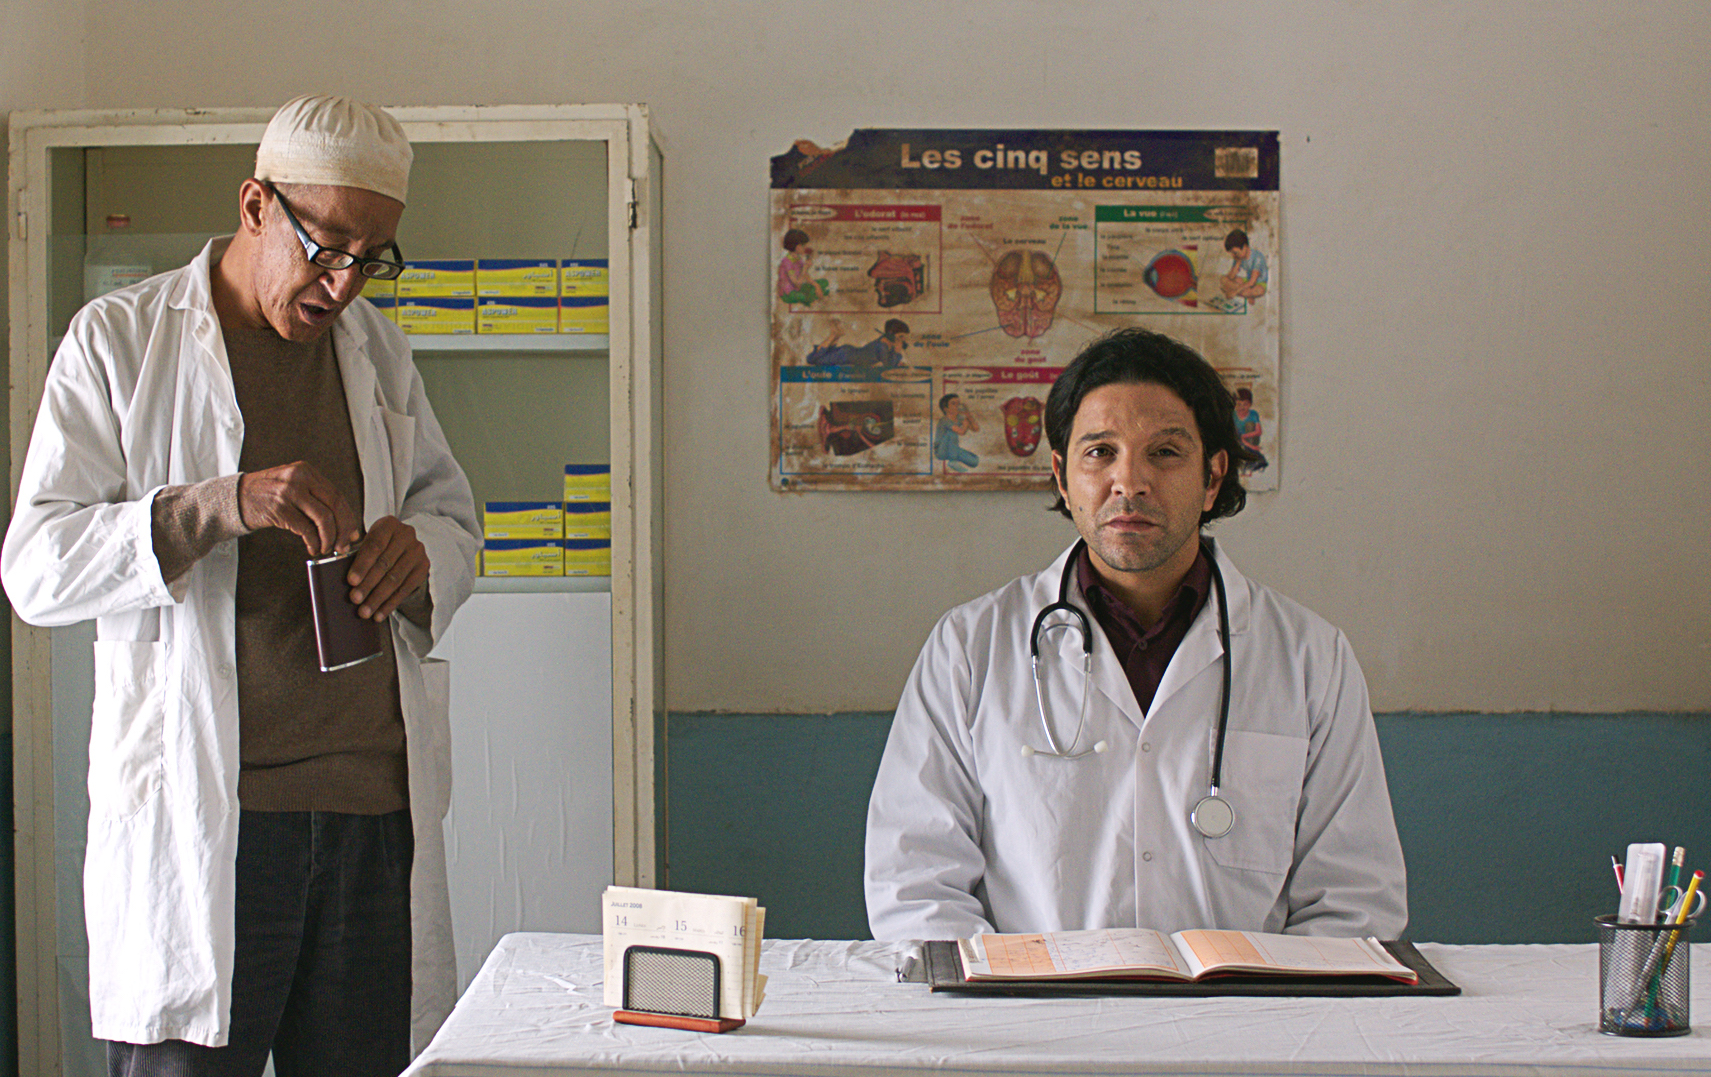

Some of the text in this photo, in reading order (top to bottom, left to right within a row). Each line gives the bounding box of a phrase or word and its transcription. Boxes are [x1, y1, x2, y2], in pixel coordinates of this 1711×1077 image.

[901, 143, 1142, 175] Les cinq sens
[1051, 172, 1183, 188] et le cerveau
[1123, 208, 1137, 218] La
[1138, 210, 1158, 218] vue
[400, 272, 436, 280] ASPOWER
[565, 269, 601, 278] ASPOWER
[401, 309, 437, 317] ASPOWER
[482, 308, 518, 316] ASPOWER
[1001, 371, 1014, 379] Le
[615, 915, 628, 927] 14
[674, 919, 688, 931] 15
[733, 925, 746, 937] 16
